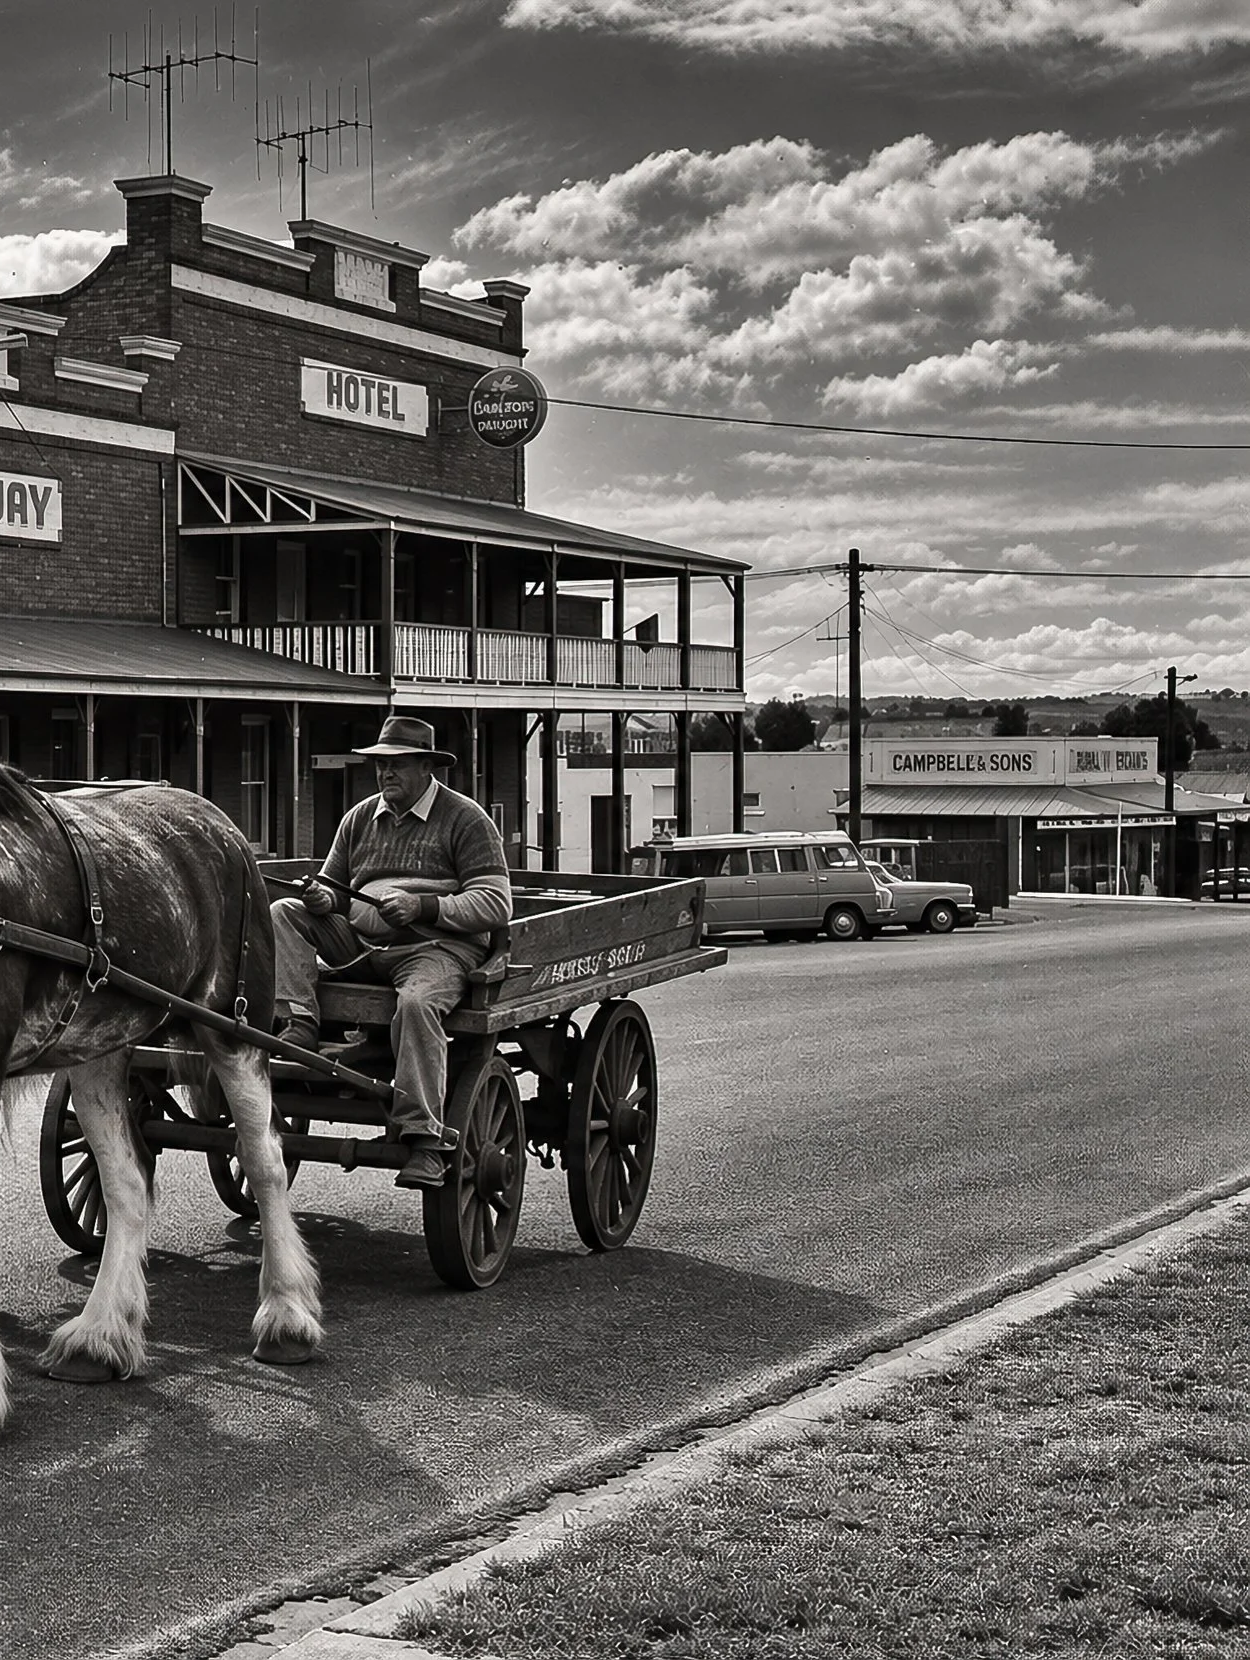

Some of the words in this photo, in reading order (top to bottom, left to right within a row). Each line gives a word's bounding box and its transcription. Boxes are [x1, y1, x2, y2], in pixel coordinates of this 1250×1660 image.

[327, 371, 406, 422] HOTEL
[977, 755, 987, 772] &
[990, 753, 1032, 772] SONS
